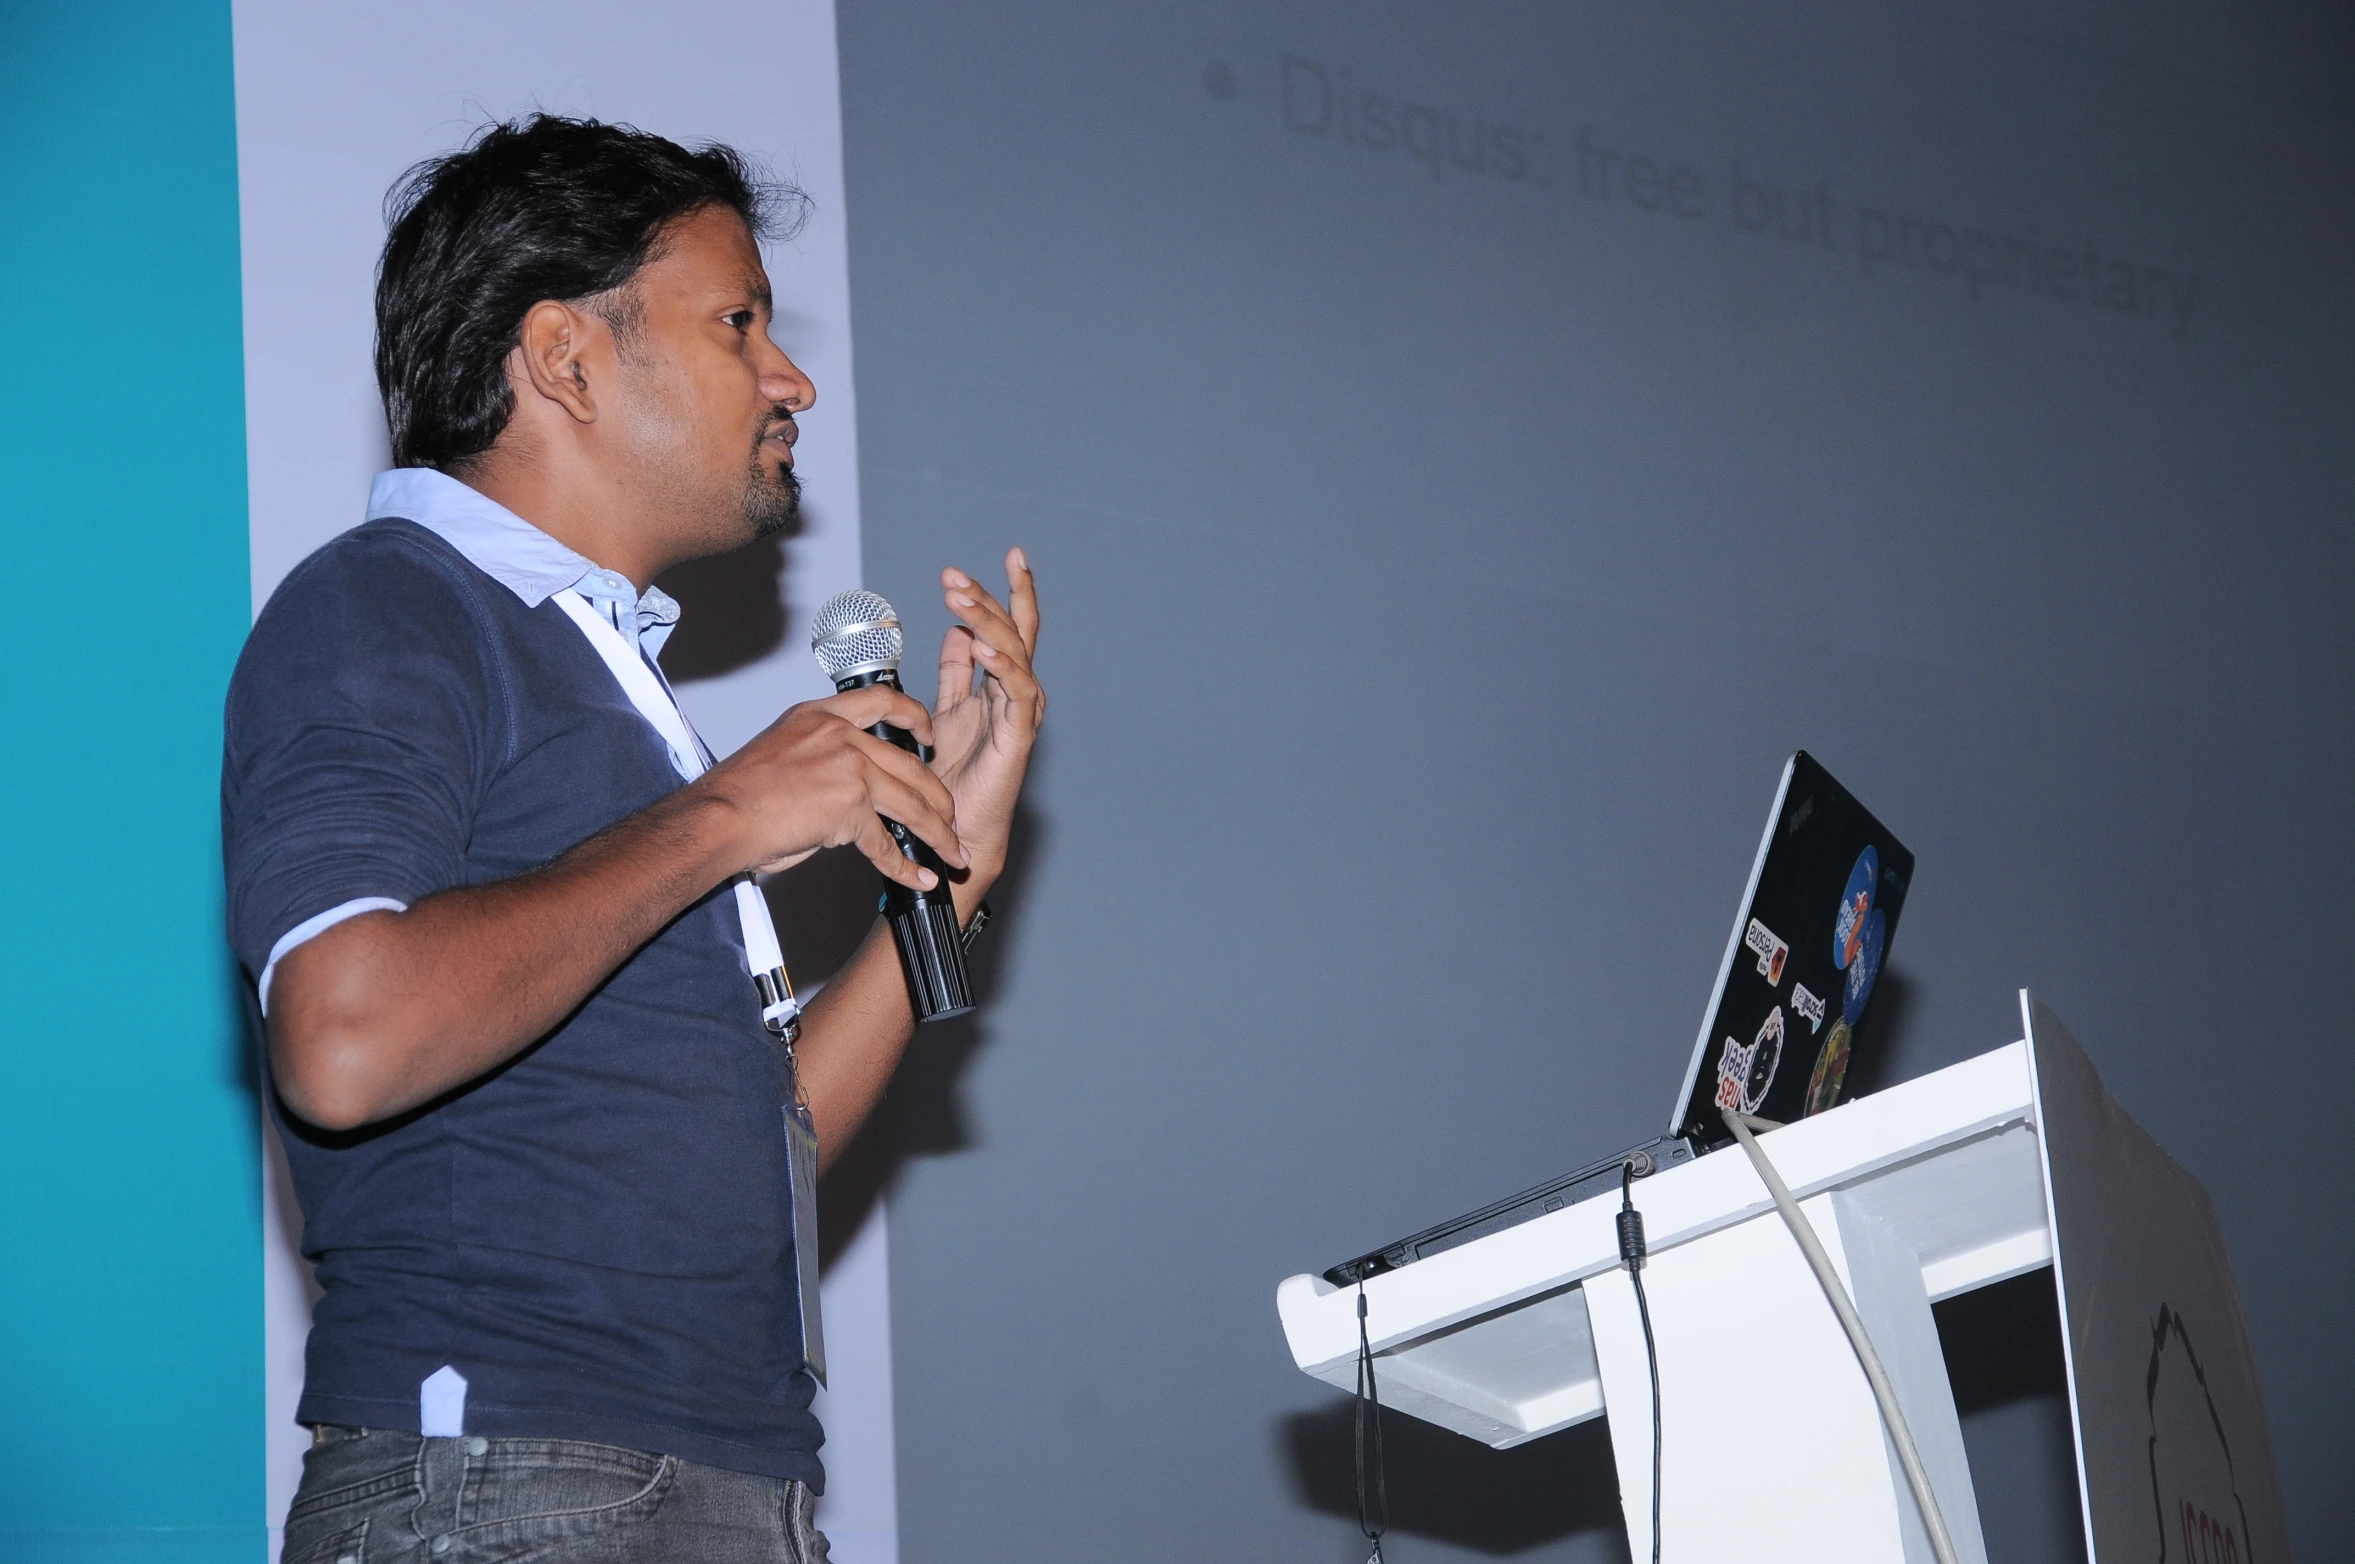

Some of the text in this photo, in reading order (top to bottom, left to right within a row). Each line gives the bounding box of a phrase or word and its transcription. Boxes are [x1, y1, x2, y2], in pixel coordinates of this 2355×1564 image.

[1281, 52, 2202, 342] Disqus: free but proprietary
[1749, 924, 1775, 964] Persona
[1721, 1042, 1751, 1083] geek
